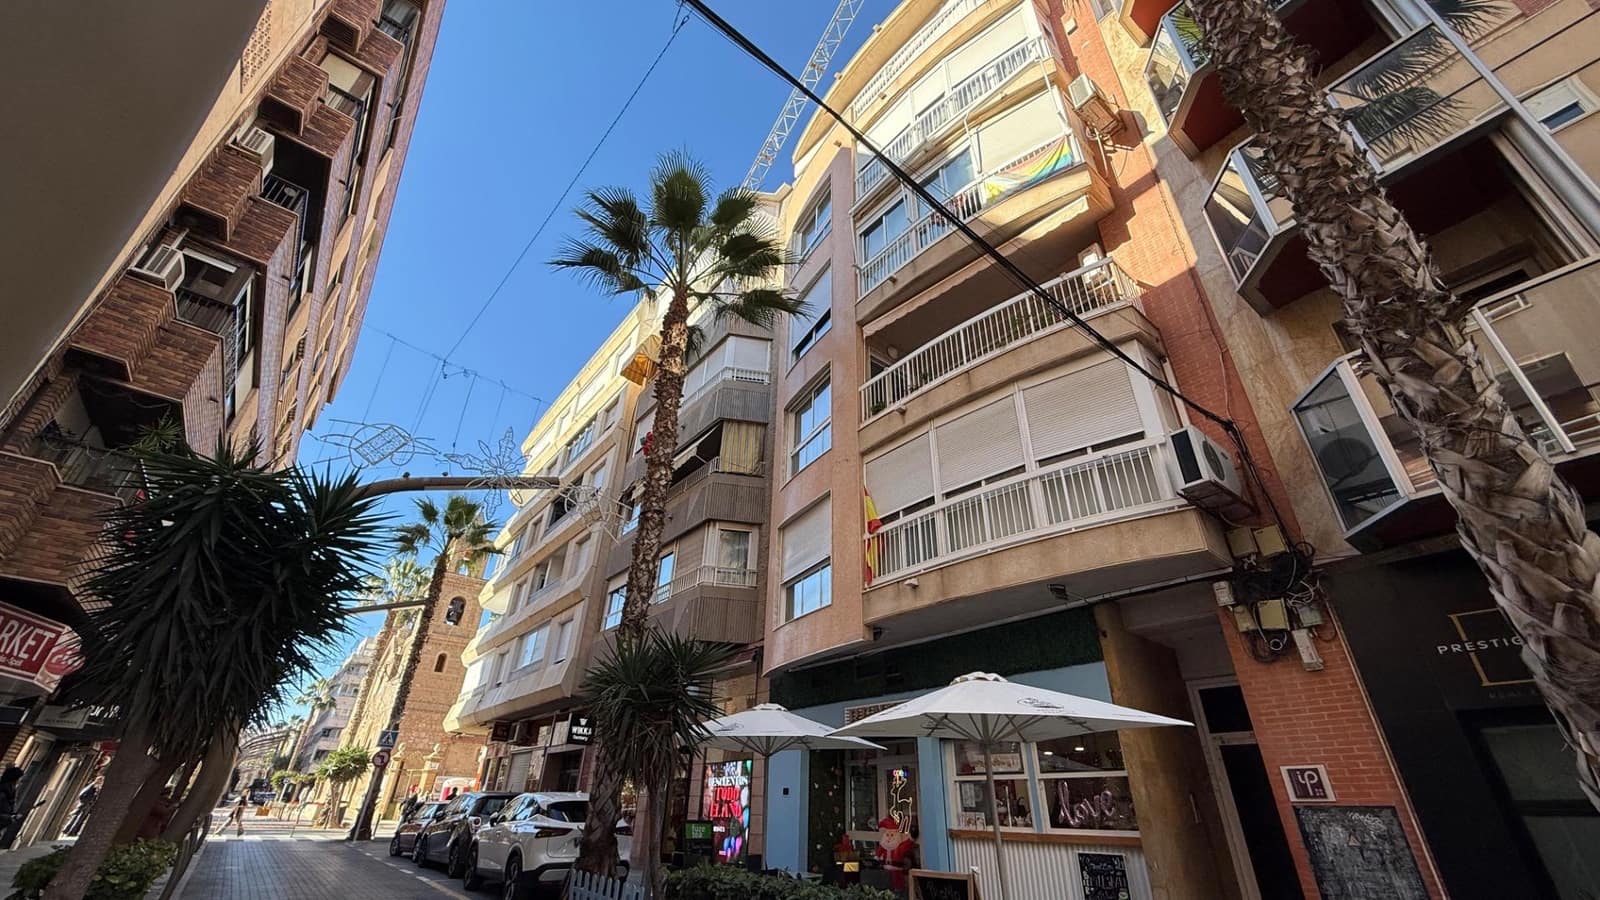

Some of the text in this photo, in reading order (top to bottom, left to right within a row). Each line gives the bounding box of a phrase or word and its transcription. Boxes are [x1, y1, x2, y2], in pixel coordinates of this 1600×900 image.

[0, 615, 56, 661] RKET
[1437, 636, 1524, 654] PRESTIG
[714, 787, 740, 801] TODO
[1058, 780, 1115, 826] love
